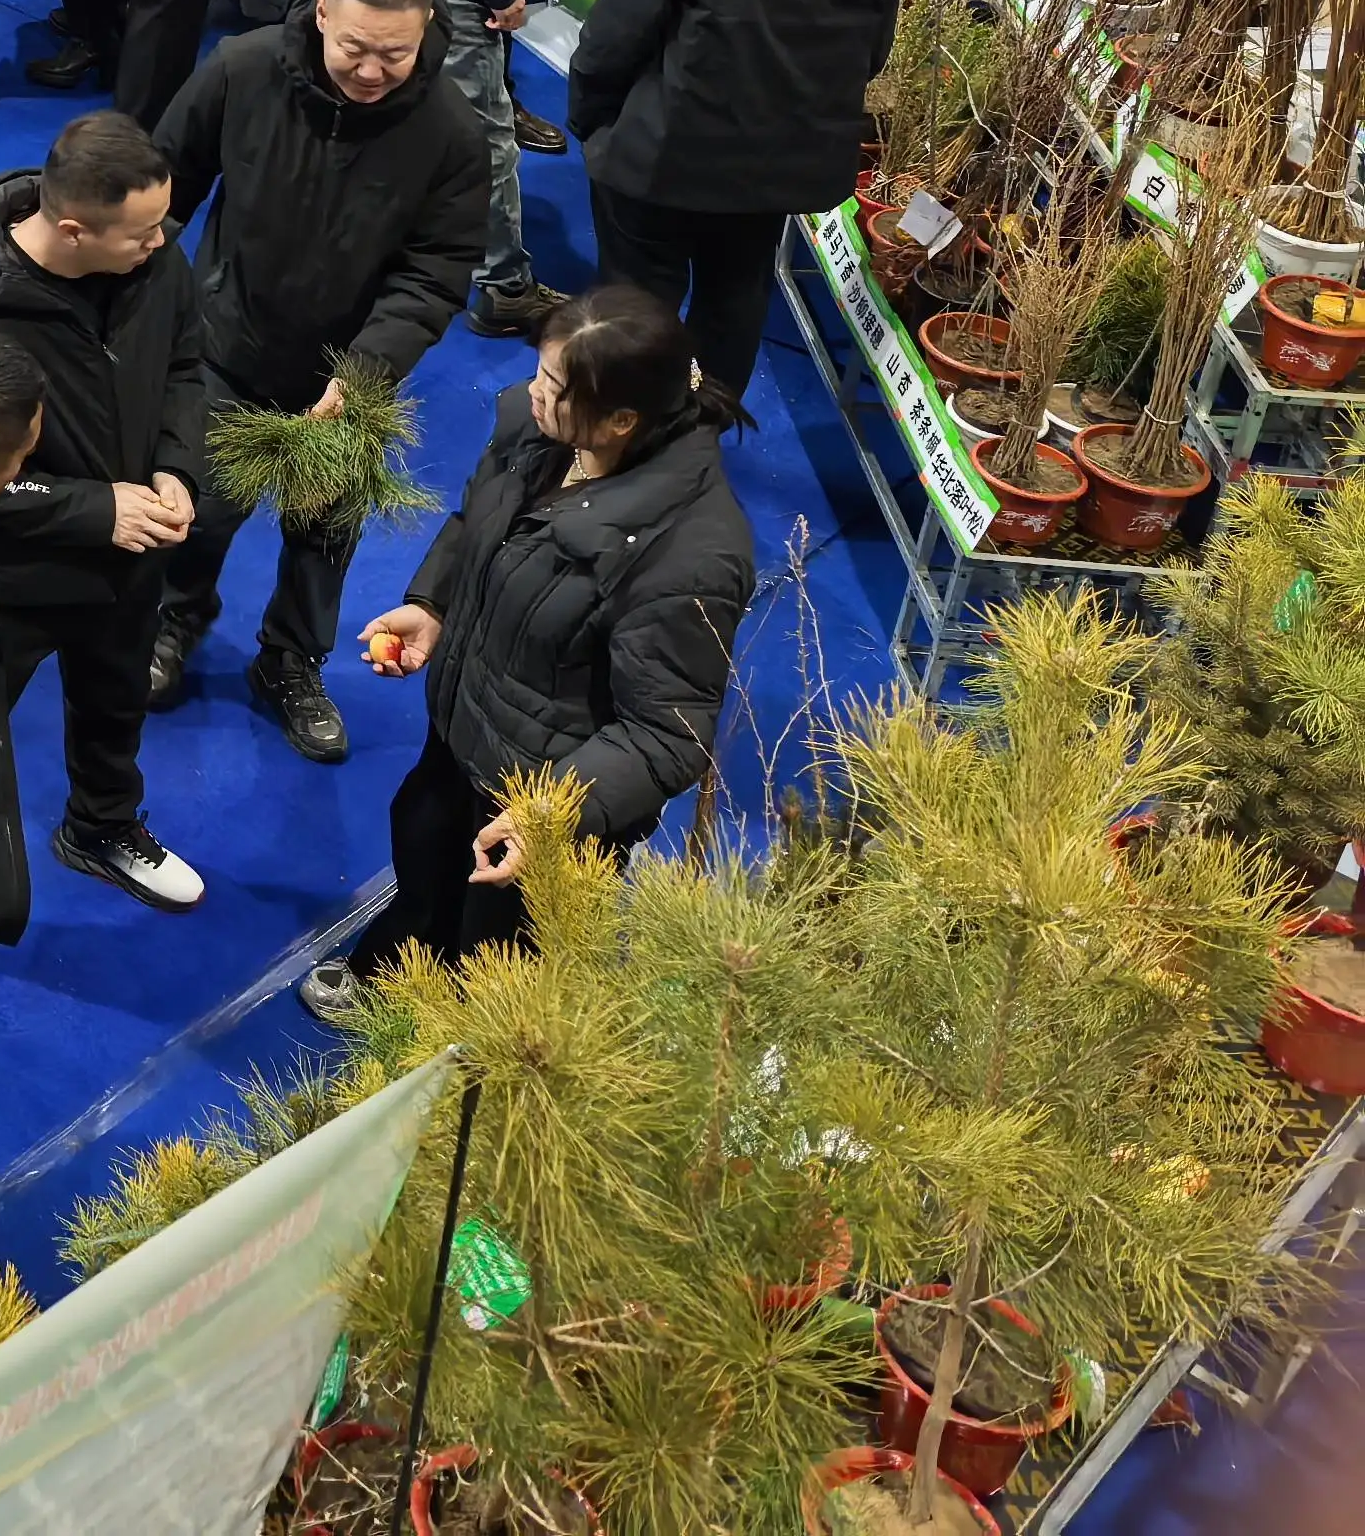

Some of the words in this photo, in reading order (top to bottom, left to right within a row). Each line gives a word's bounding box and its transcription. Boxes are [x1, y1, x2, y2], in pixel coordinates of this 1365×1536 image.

[885, 351, 914, 396] 山杏
[930, 453, 985, 540] 华北落叶松
